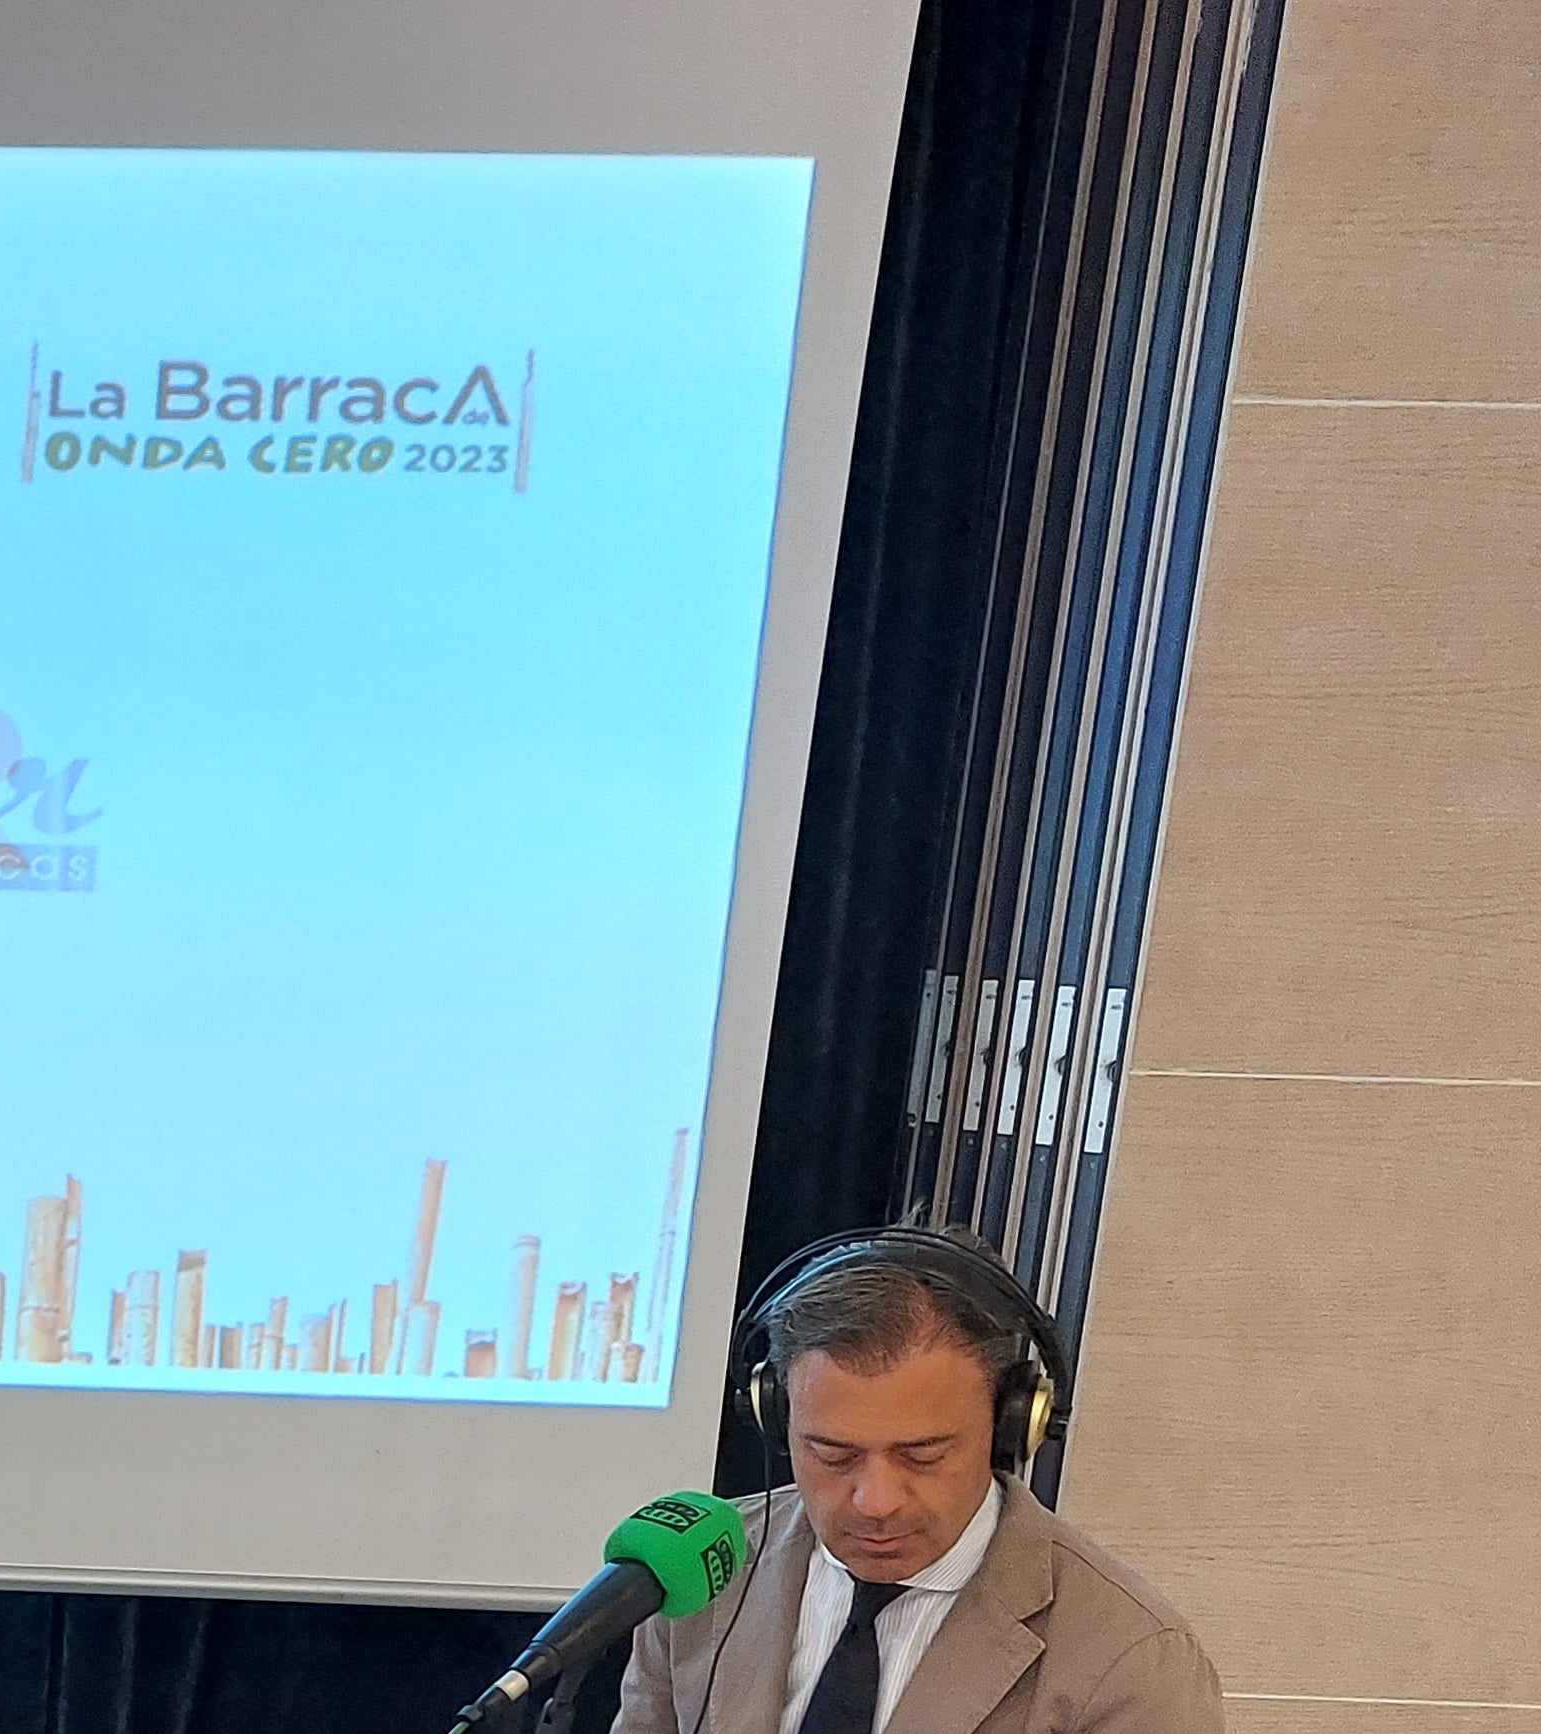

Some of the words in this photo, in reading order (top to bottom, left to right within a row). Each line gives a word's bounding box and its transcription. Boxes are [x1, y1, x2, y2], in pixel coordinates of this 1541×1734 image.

[49, 370, 125, 419] La
[45, 431, 226, 471] ONDA
[247, 434, 394, 474] CERO
[404, 444, 509, 474] 2023
